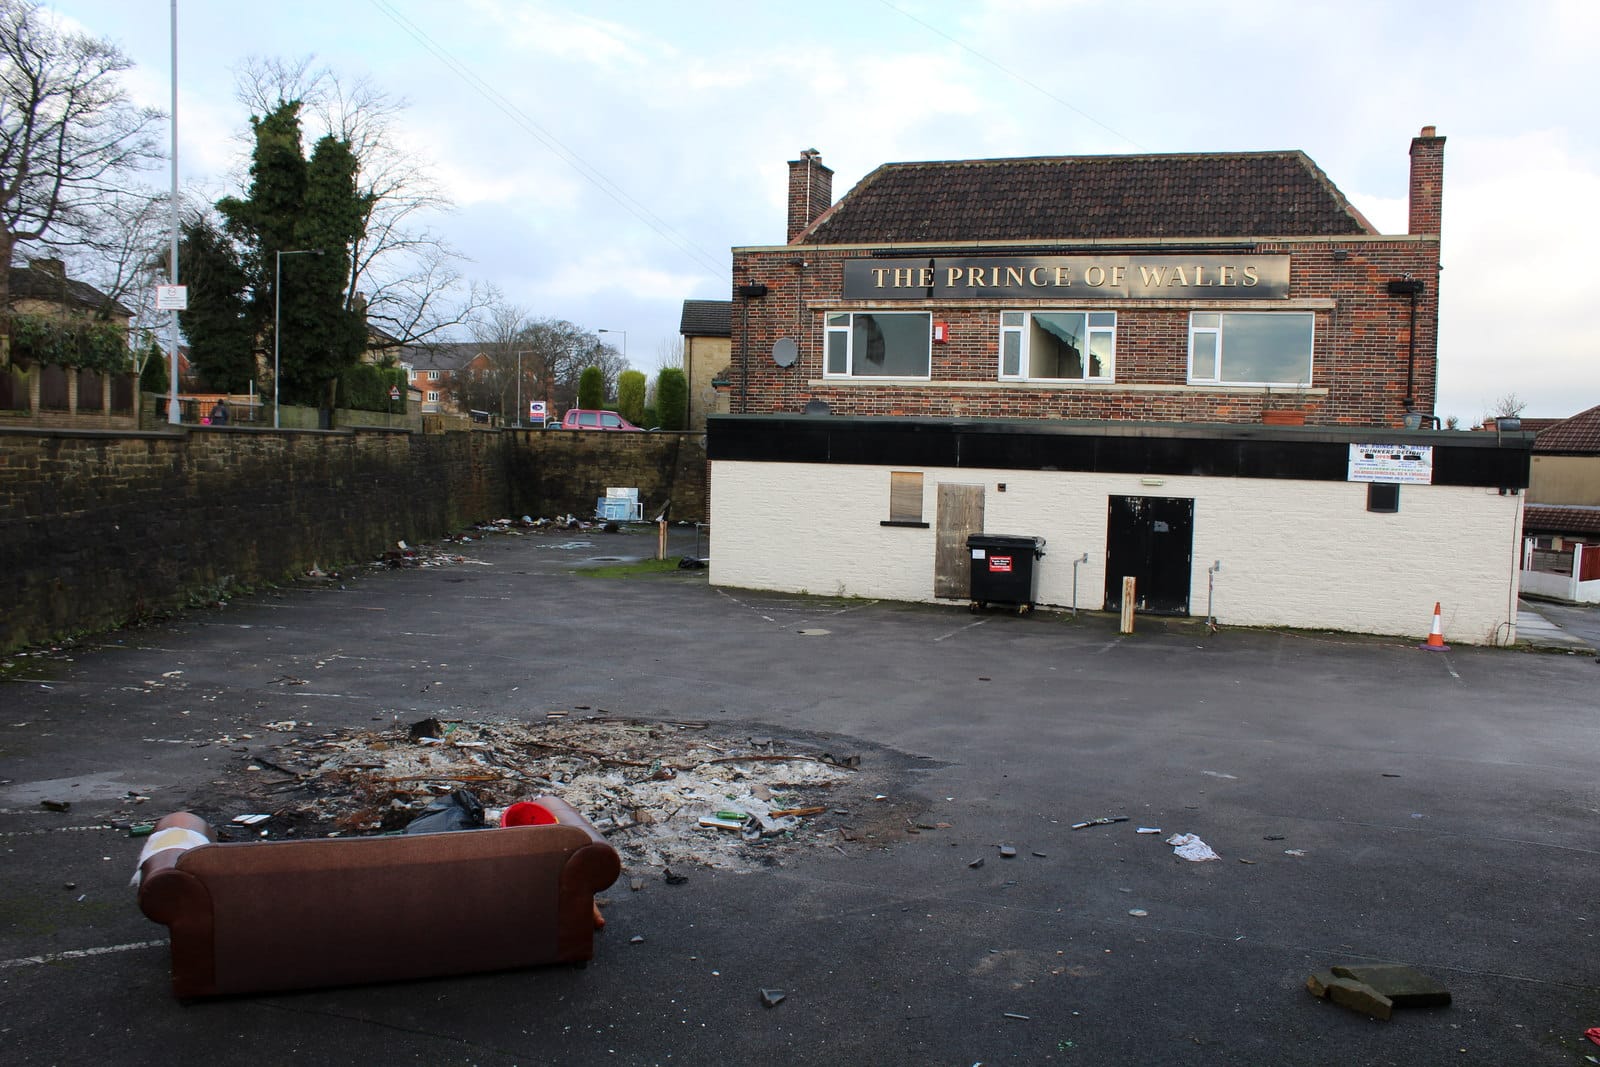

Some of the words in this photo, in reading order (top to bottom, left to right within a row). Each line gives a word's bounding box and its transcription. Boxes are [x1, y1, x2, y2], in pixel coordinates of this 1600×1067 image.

[871, 267, 935, 288] THE
[945, 265, 1071, 288] PRINCE
[1084, 265, 1128, 287] OF
[1138, 265, 1259, 288] WALES
